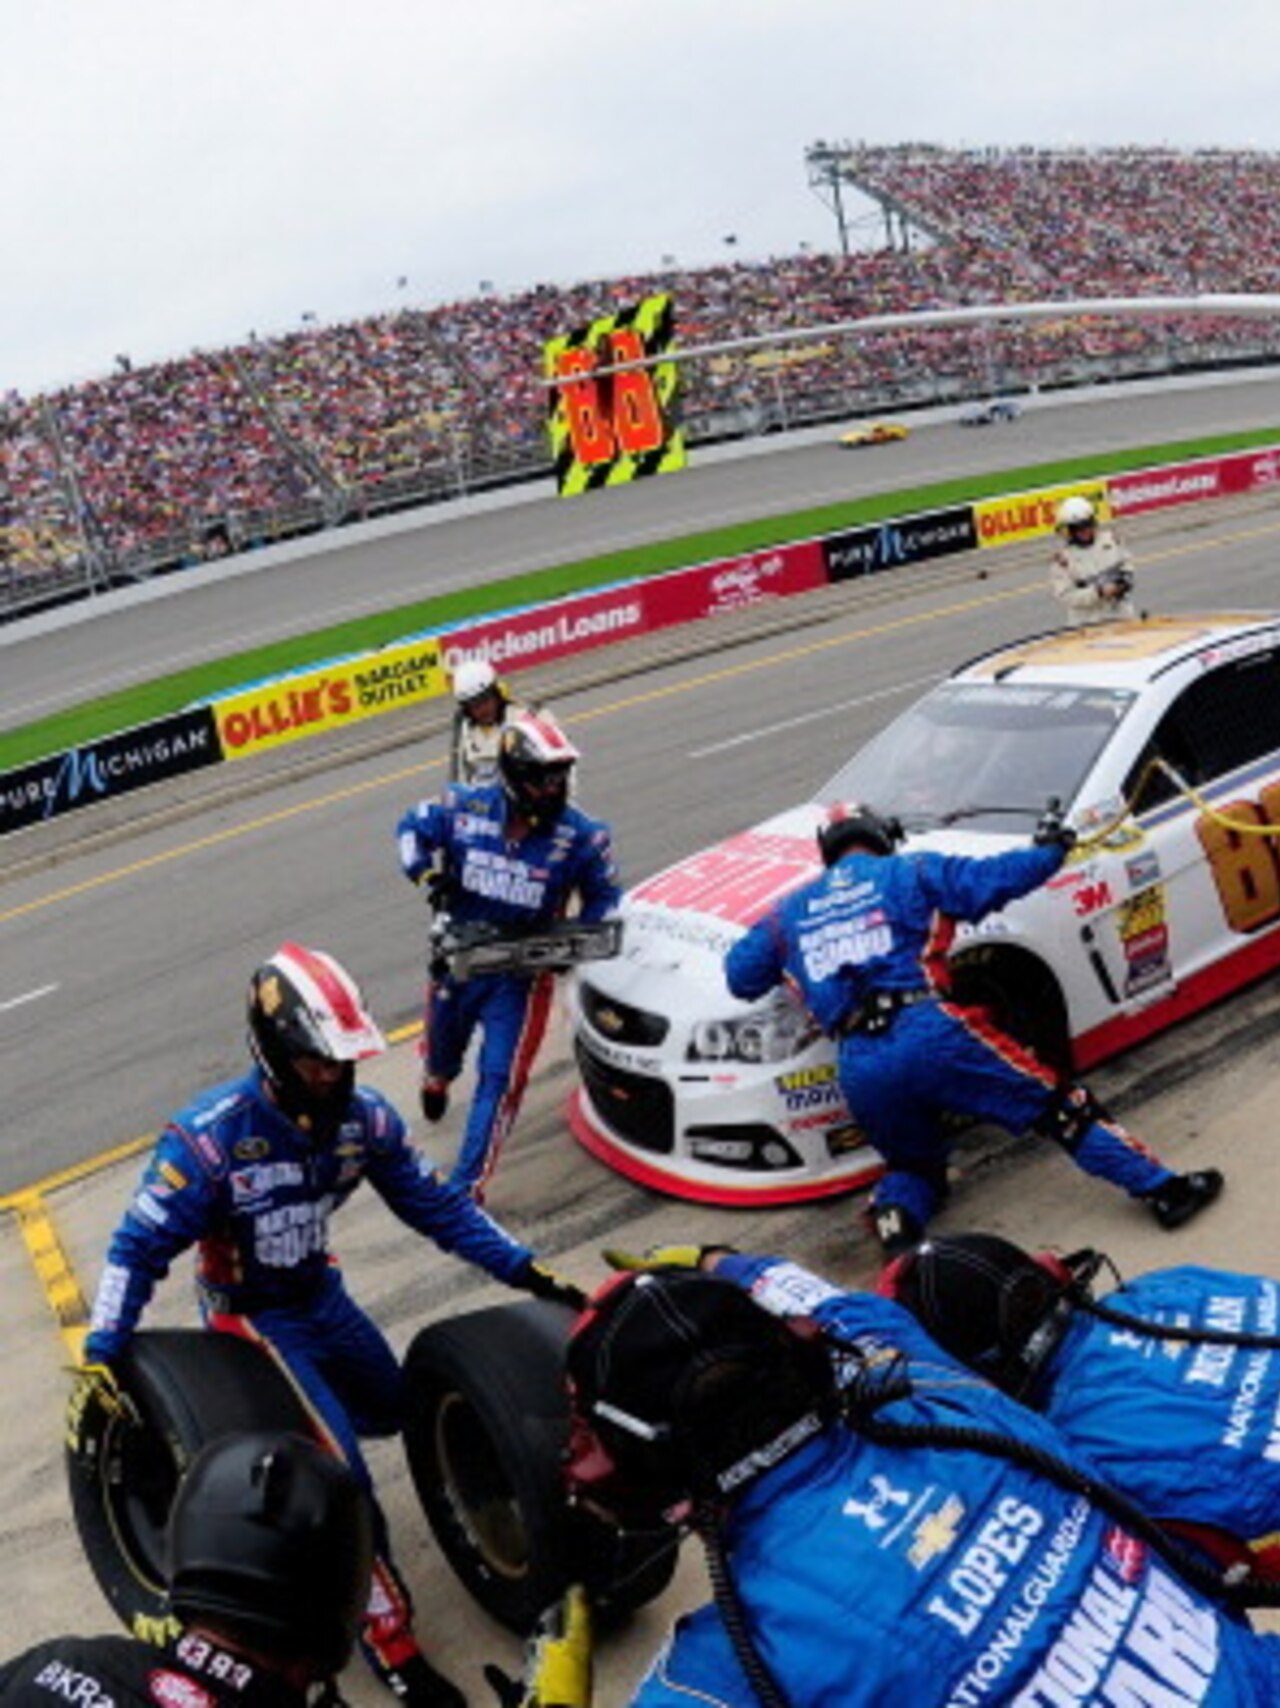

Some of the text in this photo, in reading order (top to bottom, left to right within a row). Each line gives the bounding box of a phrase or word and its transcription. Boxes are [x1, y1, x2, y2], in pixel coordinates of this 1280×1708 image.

[444, 604, 642, 669] Quicken Loans
[354, 651, 439, 689] BARGAIN
[357, 673, 428, 707] OUTLET
[224, 679, 353, 748] OLLIE'S
[1074, 881, 1113, 917] 3M
[928, 1496, 1044, 1636] LOPES
